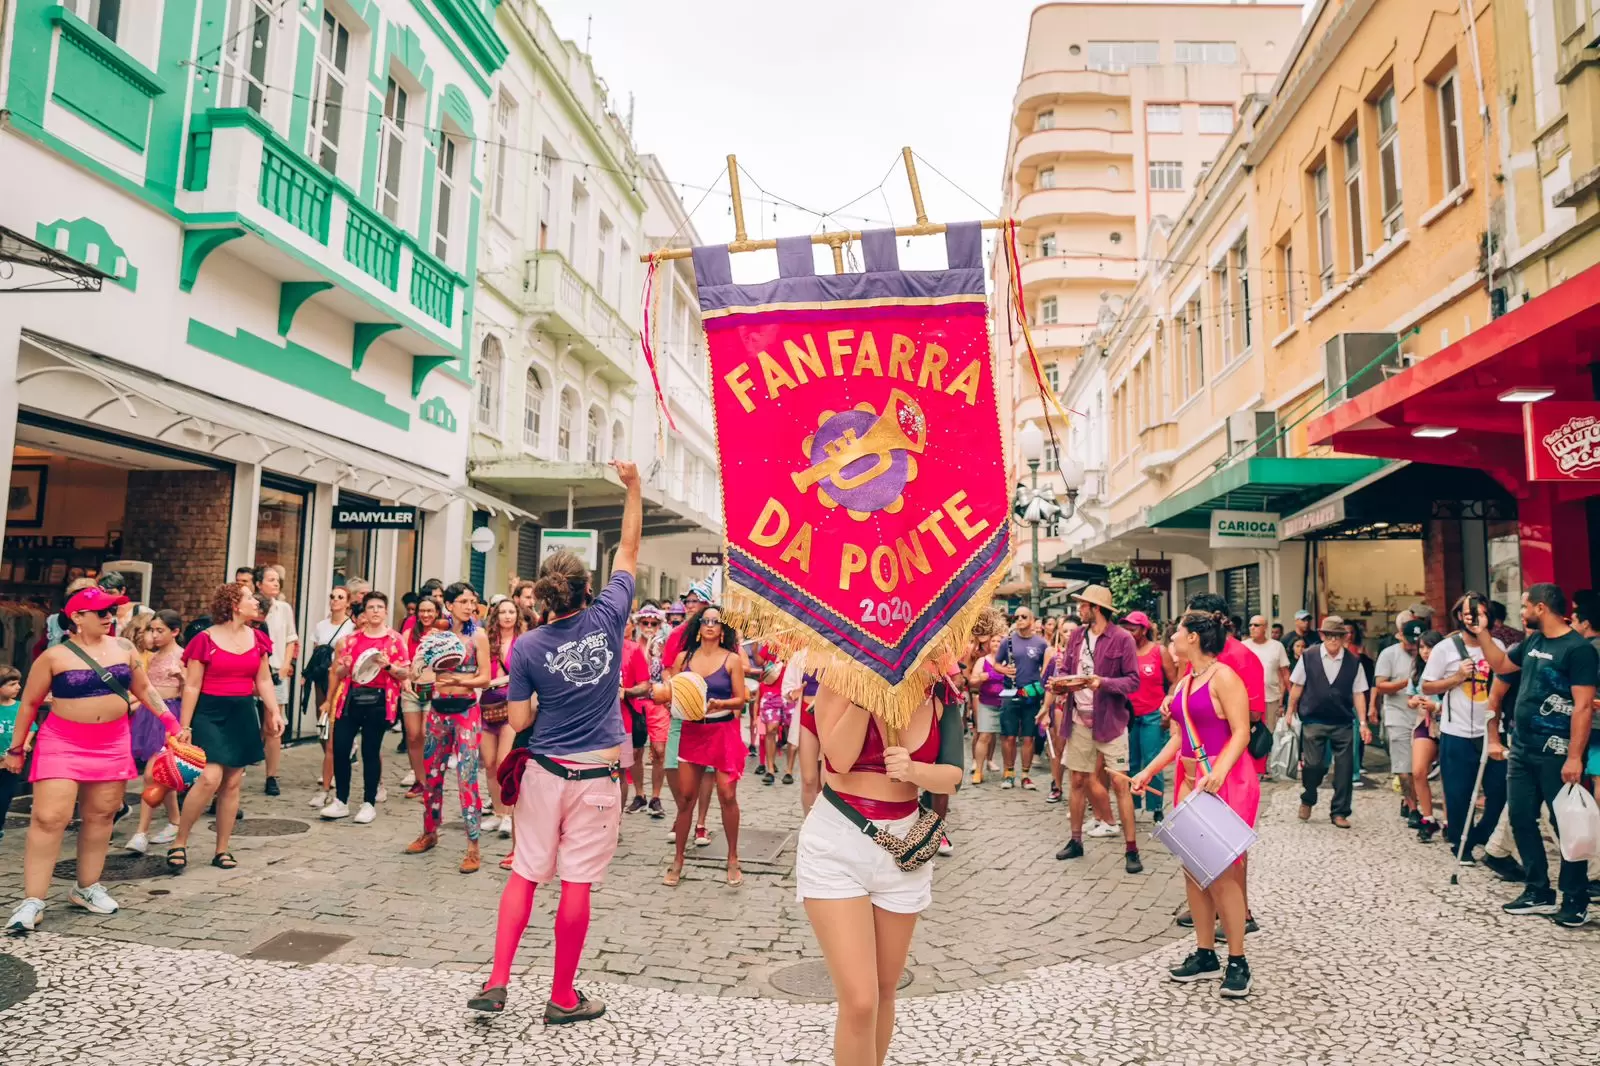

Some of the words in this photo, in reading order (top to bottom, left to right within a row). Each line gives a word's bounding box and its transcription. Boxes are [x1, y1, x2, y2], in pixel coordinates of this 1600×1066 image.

[724, 329, 981, 413] FANFARRA
[339, 511, 413, 523] DAMYLLER
[1218, 520, 1276, 532] CARIOCA
[748, 497, 812, 573] DA
[839, 490, 990, 592] PONTE
[695, 553, 719, 564] vivo
[859, 597, 912, 626] 2020
